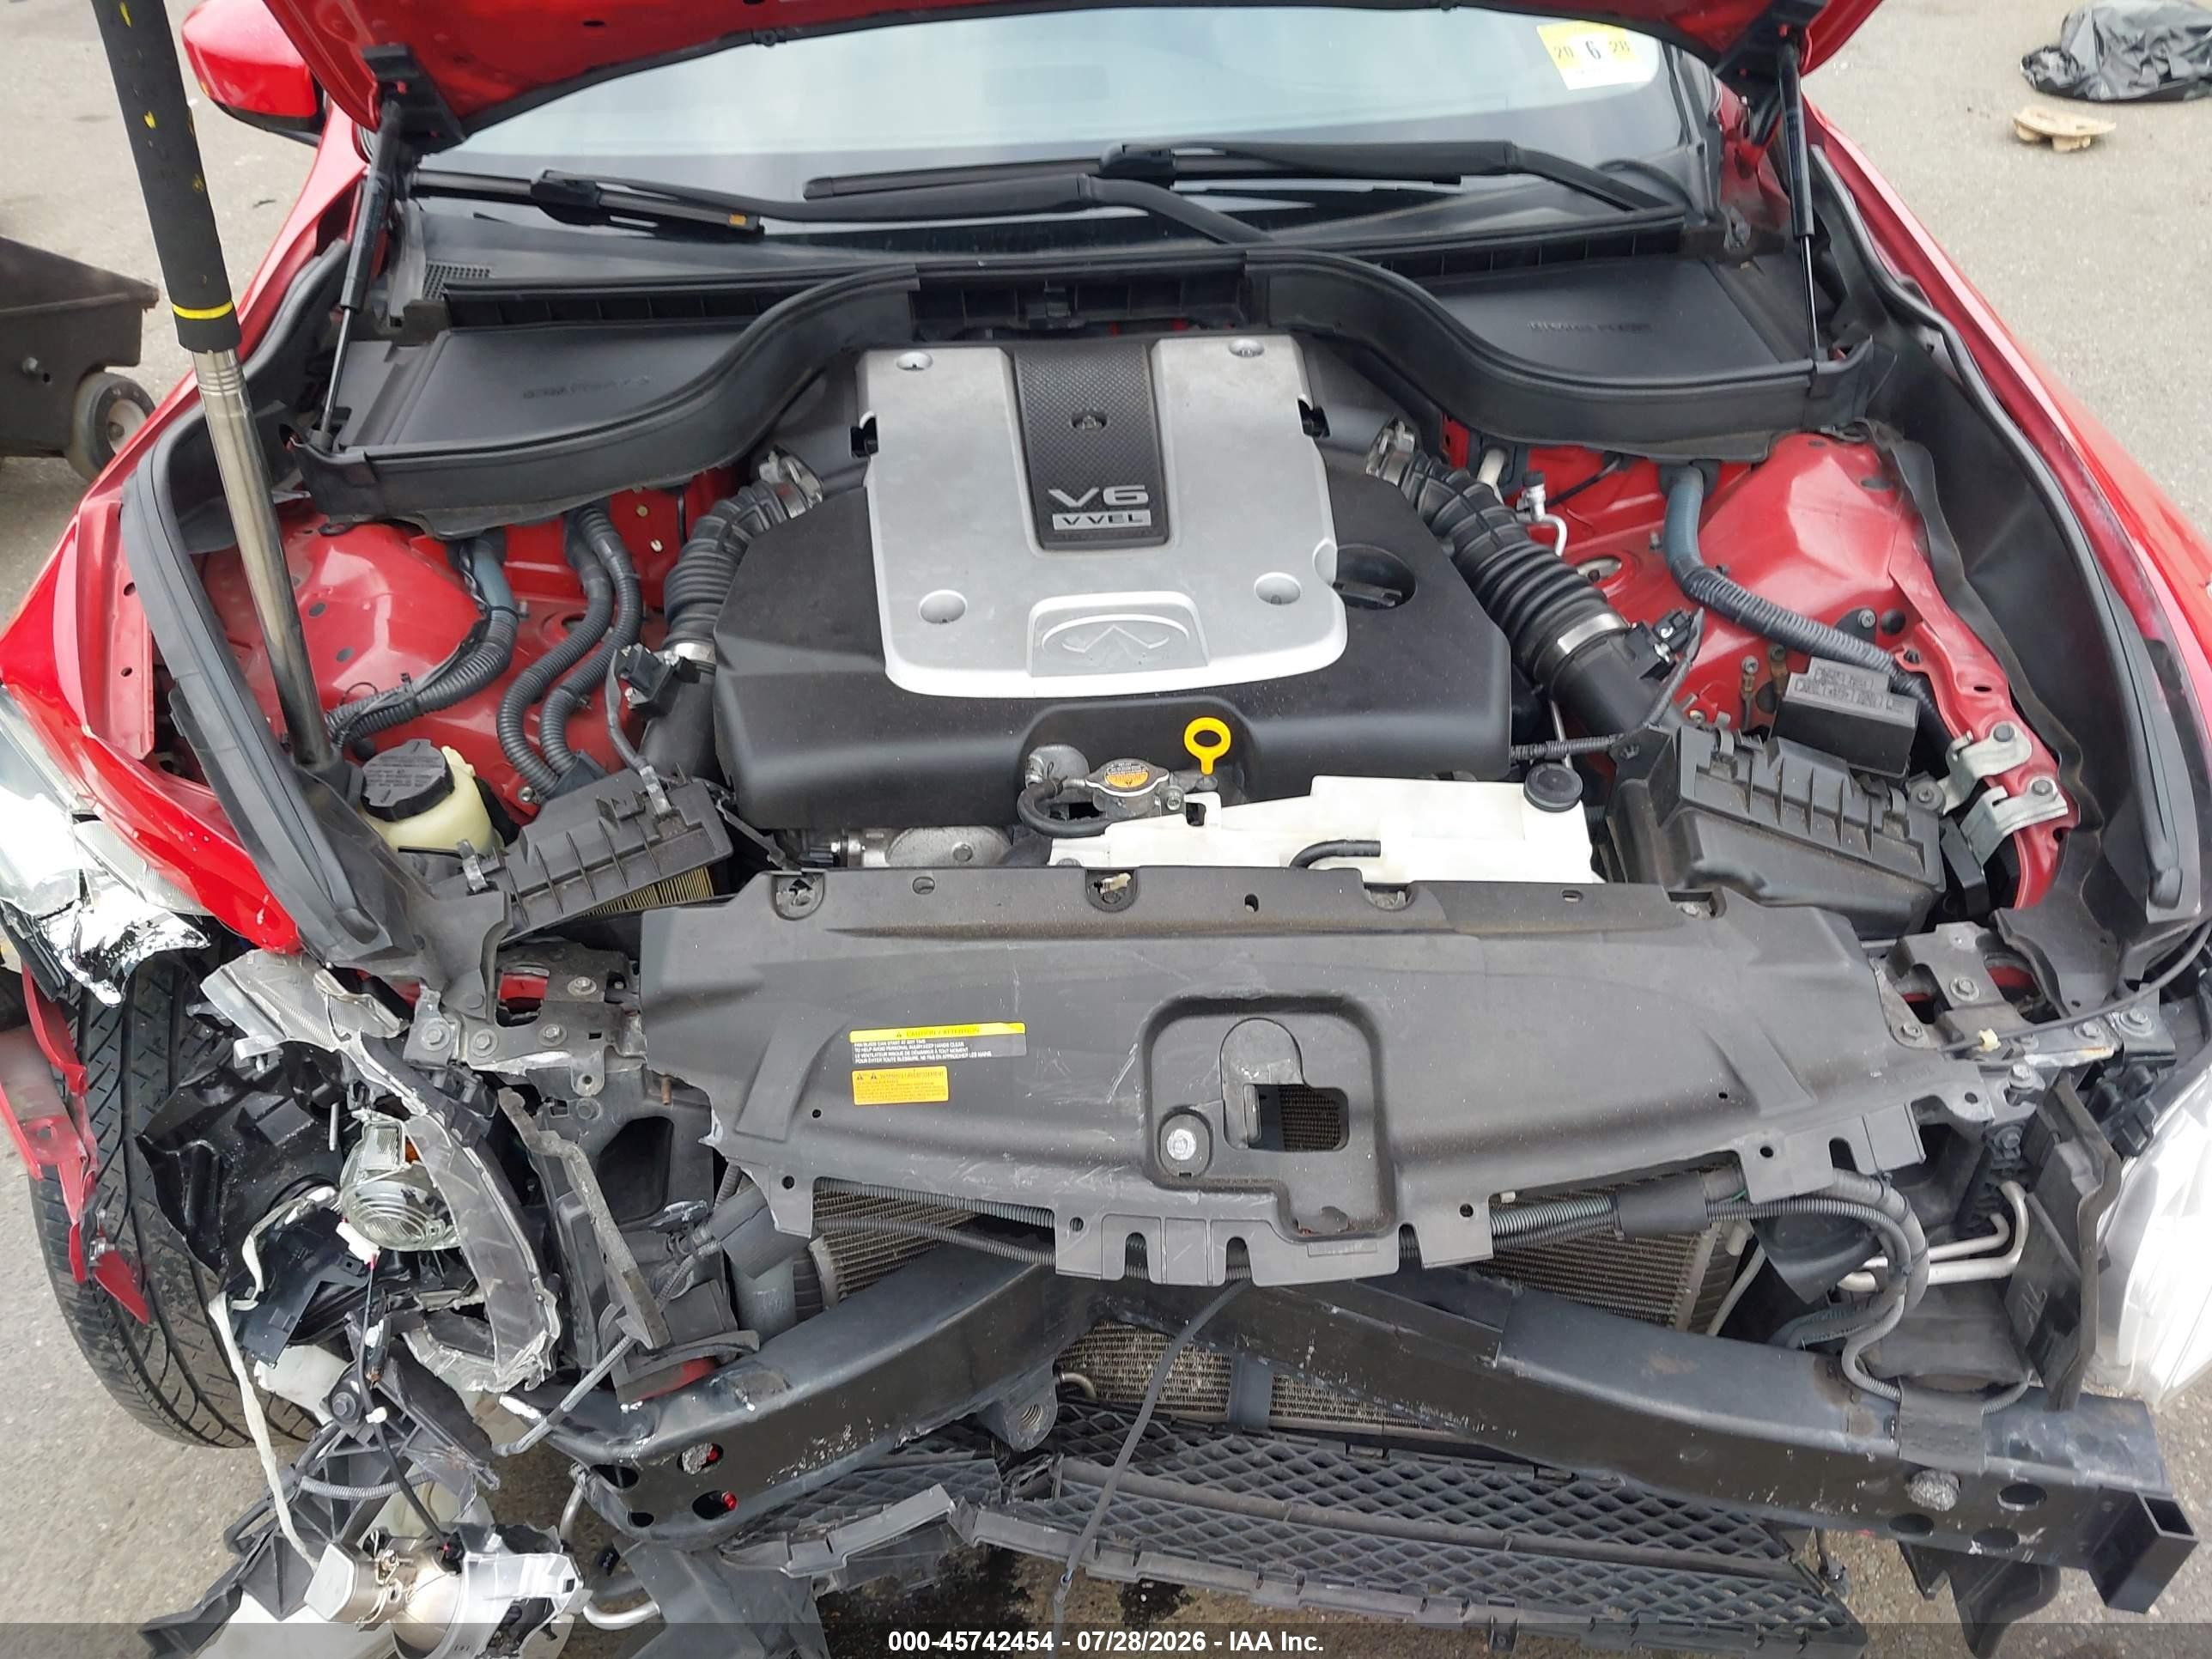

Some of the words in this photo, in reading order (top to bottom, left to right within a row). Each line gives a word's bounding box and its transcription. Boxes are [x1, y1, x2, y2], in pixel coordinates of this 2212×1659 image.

[1584, 40, 1601, 60] 6
[1048, 484, 1149, 508] V6
[1062, 514, 1144, 526] VVEL
